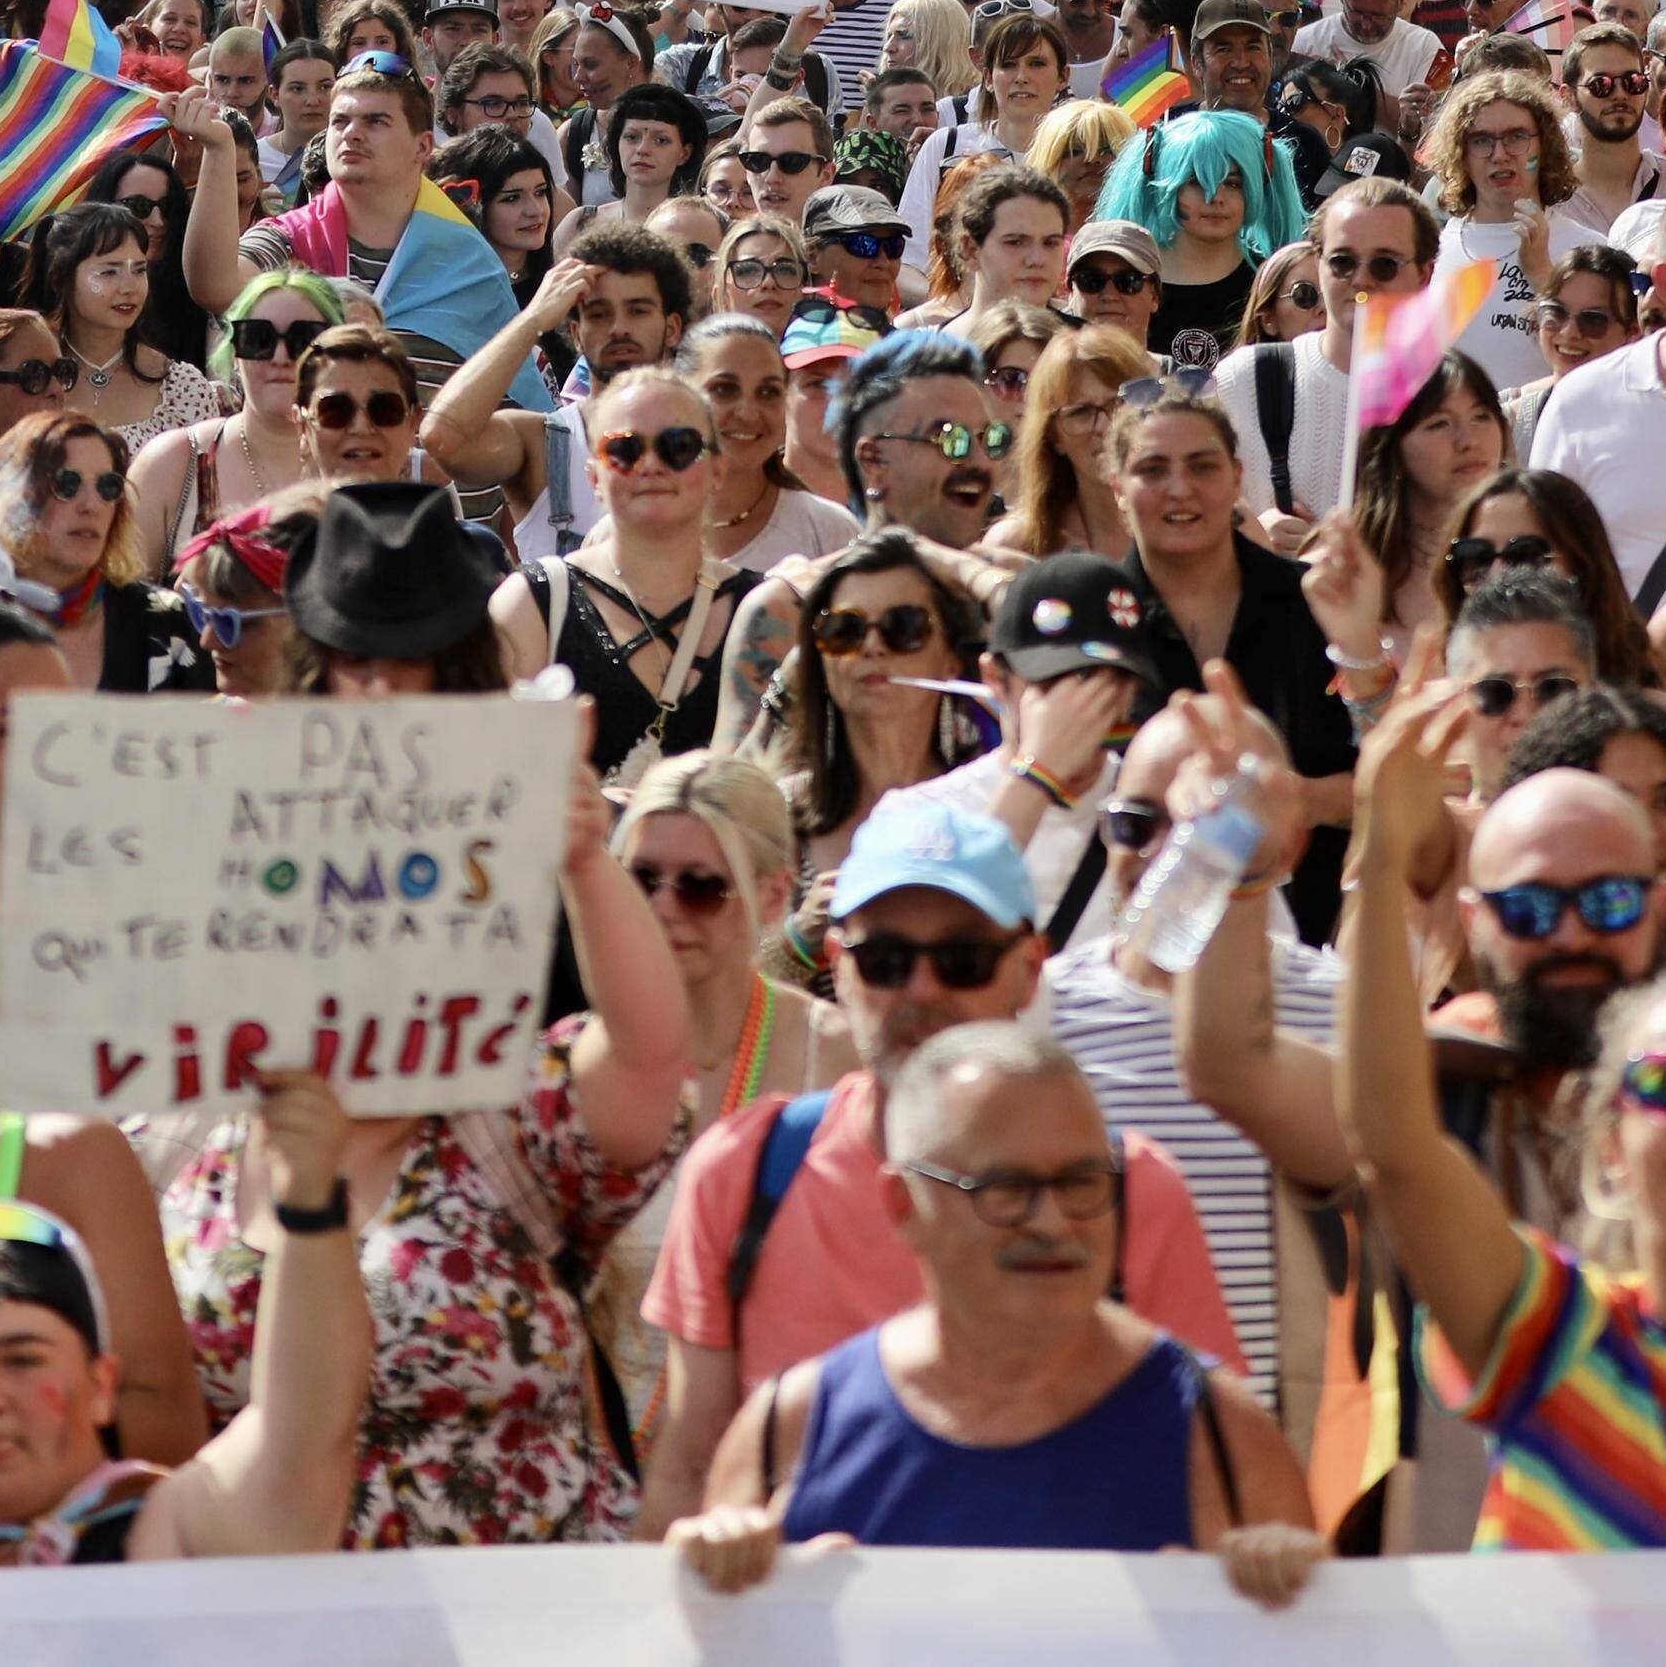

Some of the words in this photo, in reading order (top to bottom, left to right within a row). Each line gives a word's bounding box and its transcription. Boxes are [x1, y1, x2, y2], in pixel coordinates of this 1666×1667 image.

[31, 720, 223, 787] C'EST
[300, 709, 432, 788] PAS
[231, 774, 523, 837] ATTAQUER
[26, 826, 143, 875] LES
[219, 838, 496, 909] HOMOS
[125, 914, 189, 961] TE
[207, 906, 423, 960] RENDRA
[444, 904, 526, 951] TA
